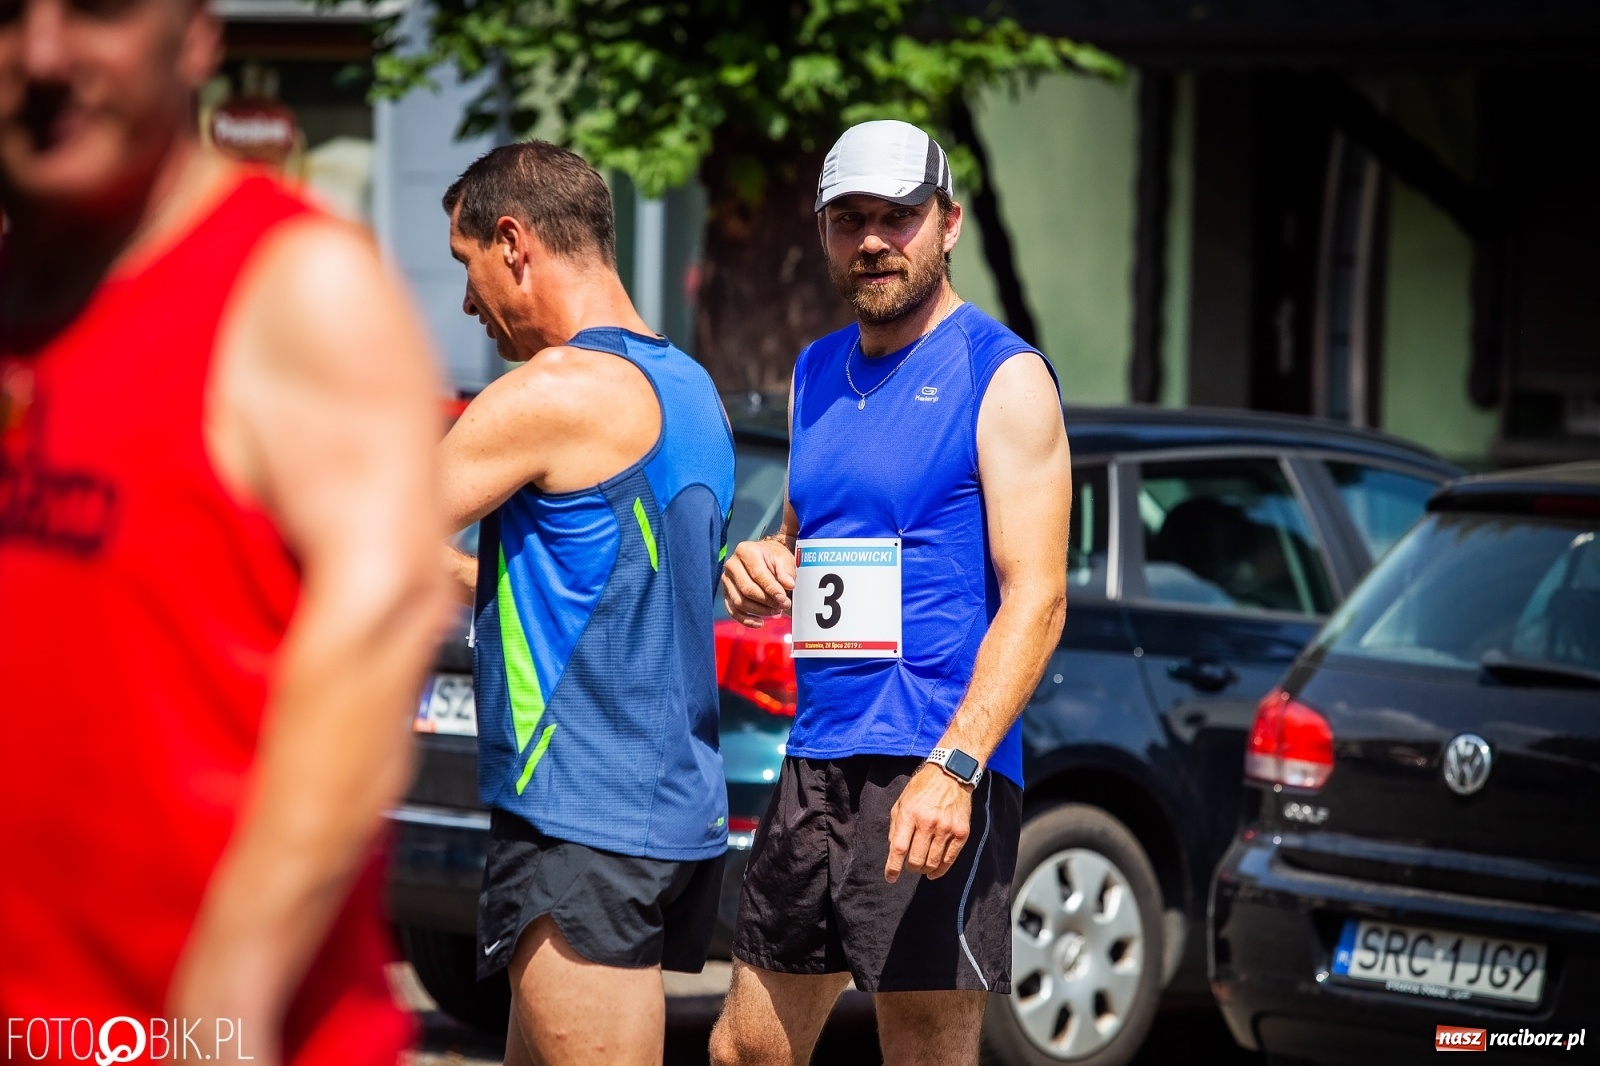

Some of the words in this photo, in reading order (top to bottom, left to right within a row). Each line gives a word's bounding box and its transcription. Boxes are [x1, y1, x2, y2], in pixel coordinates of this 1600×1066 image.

[804, 551, 817, 563] BIEG
[818, 551, 893, 562] KRZANOWICKI
[815, 573, 845, 629] 3
[832, 642, 843, 650] lipca
[1358, 926, 1435, 978] SRC
[1448, 937, 1538, 992] 1JG9
